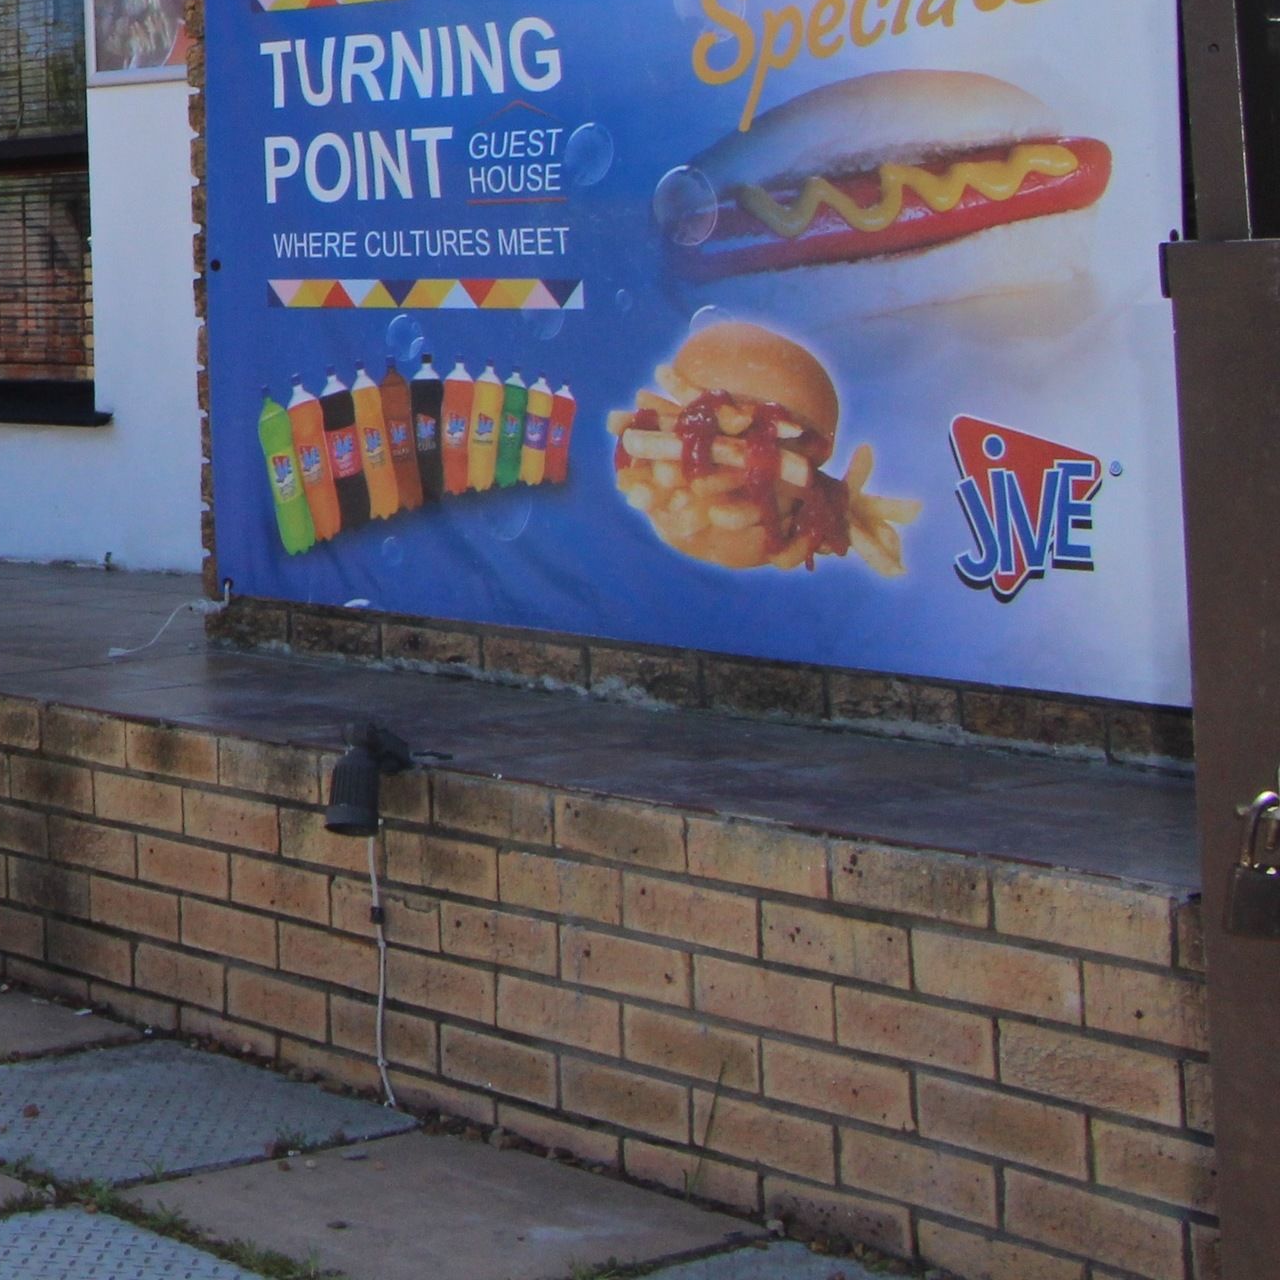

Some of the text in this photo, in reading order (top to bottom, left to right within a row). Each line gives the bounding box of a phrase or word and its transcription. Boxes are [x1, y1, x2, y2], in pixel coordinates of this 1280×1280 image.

[260, 17, 562, 109] TURNING
[468, 128, 562, 160] GUEST
[264, 126, 453, 204] POINT
[468, 163, 562, 193] HOUSE
[273, 227, 570, 258] WHERE CULTURES MEET
